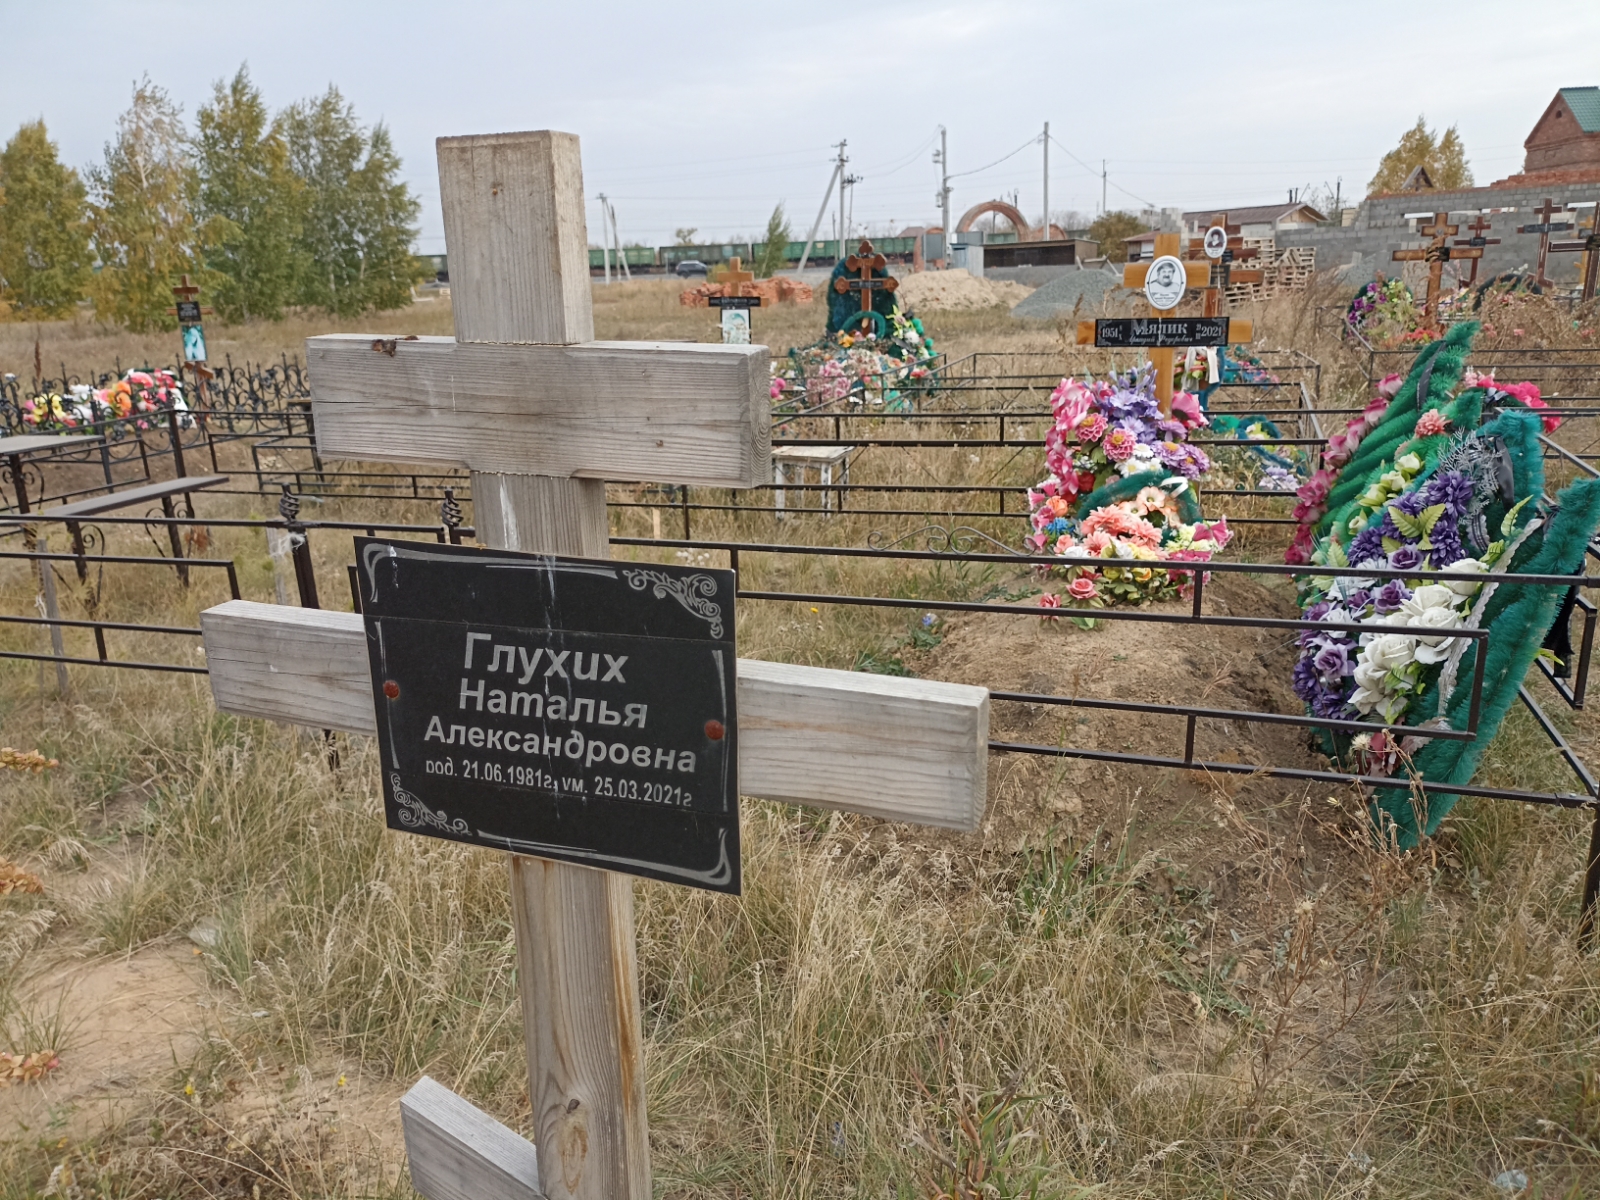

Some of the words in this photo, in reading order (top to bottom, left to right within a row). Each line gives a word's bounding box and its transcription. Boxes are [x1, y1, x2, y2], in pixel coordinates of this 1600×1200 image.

[1101, 327, 1118, 338] 1951
[1200, 326, 1222, 338] 2021
[464, 631, 629, 686] Глухих
[458, 677, 648, 730] Наталья
[424, 715, 698, 774] Александровна
[594, 776, 693, 808] 25.03.2021г
